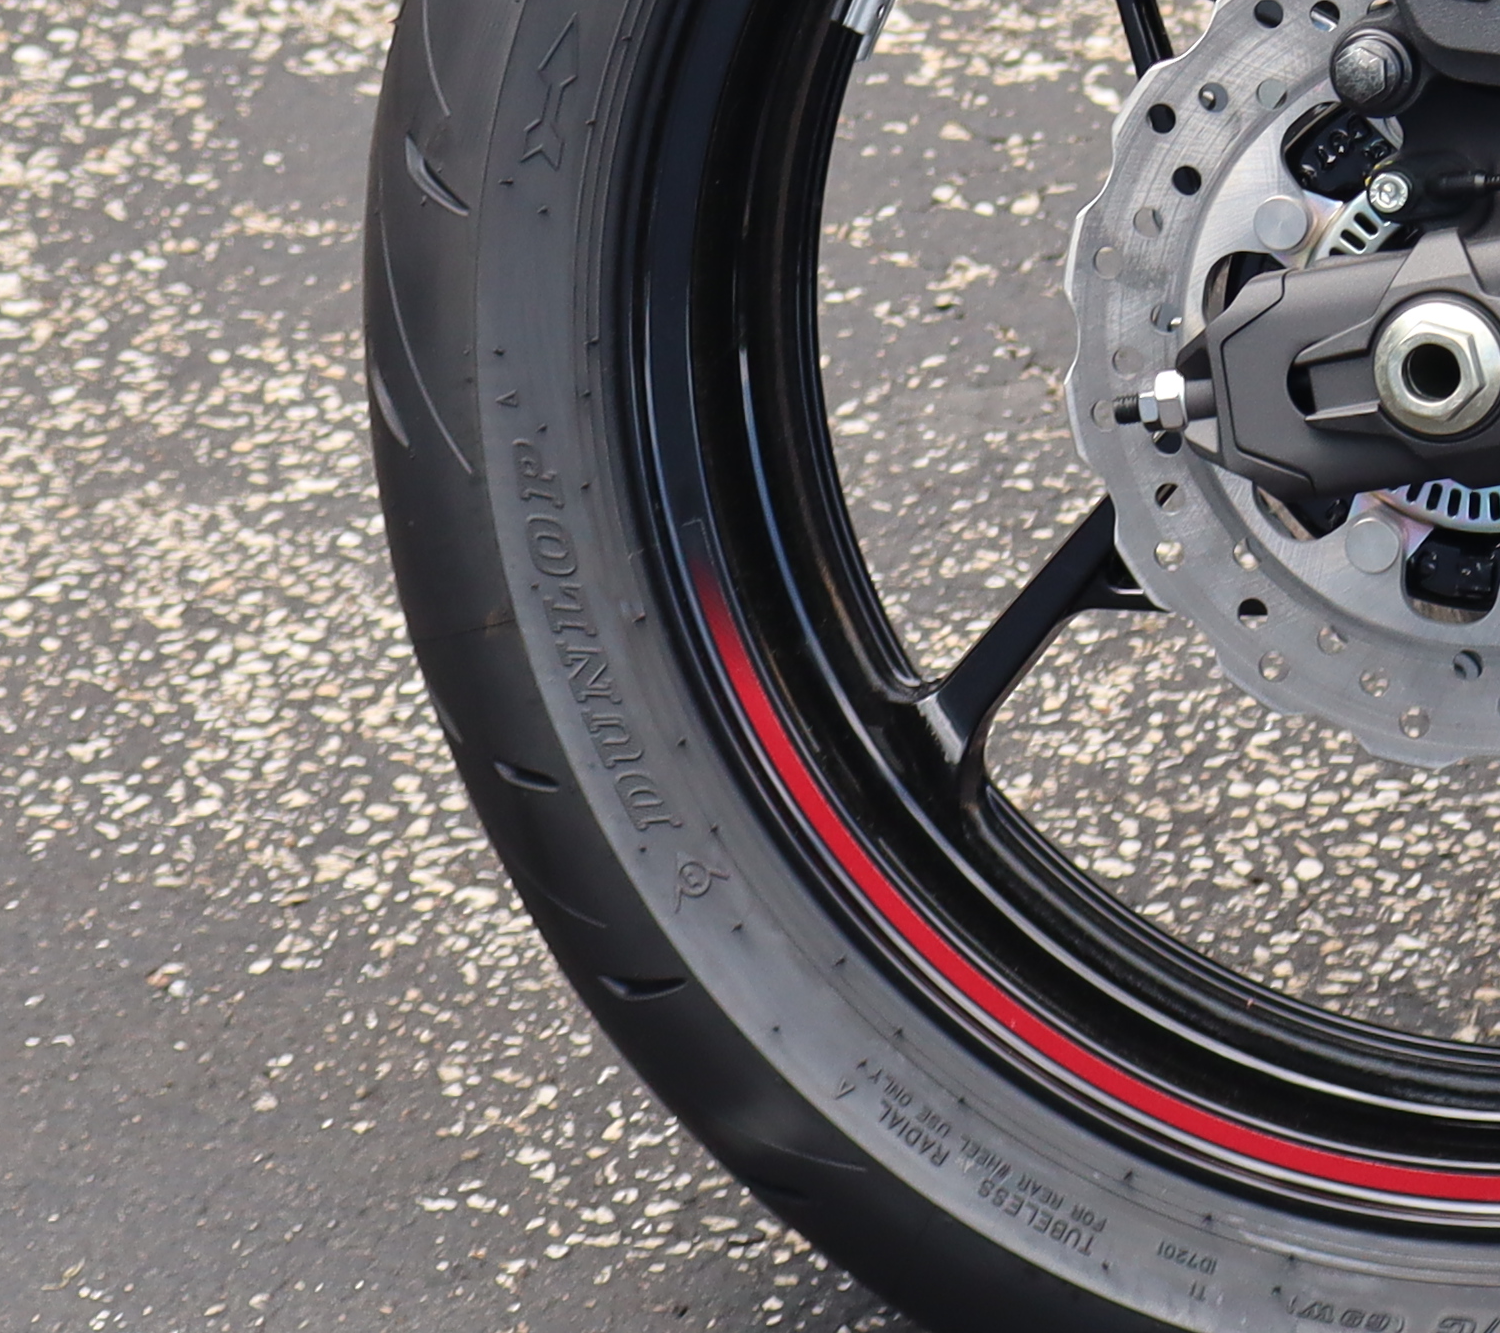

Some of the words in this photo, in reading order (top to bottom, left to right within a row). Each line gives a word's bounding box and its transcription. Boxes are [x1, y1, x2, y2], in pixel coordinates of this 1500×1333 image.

[512, 437, 683, 833] DUNLOP
[869, 1067, 917, 1110] ONLY
[879, 1100, 951, 1168] RADIAL
[916, 1104, 954, 1139] USE
[959, 1133, 1013, 1182] WHEEL
[1016, 1175, 1066, 1211] REAR
[977, 1177, 1098, 1256] TUBELESS
[1069, 1203, 1108, 1233] FOR
